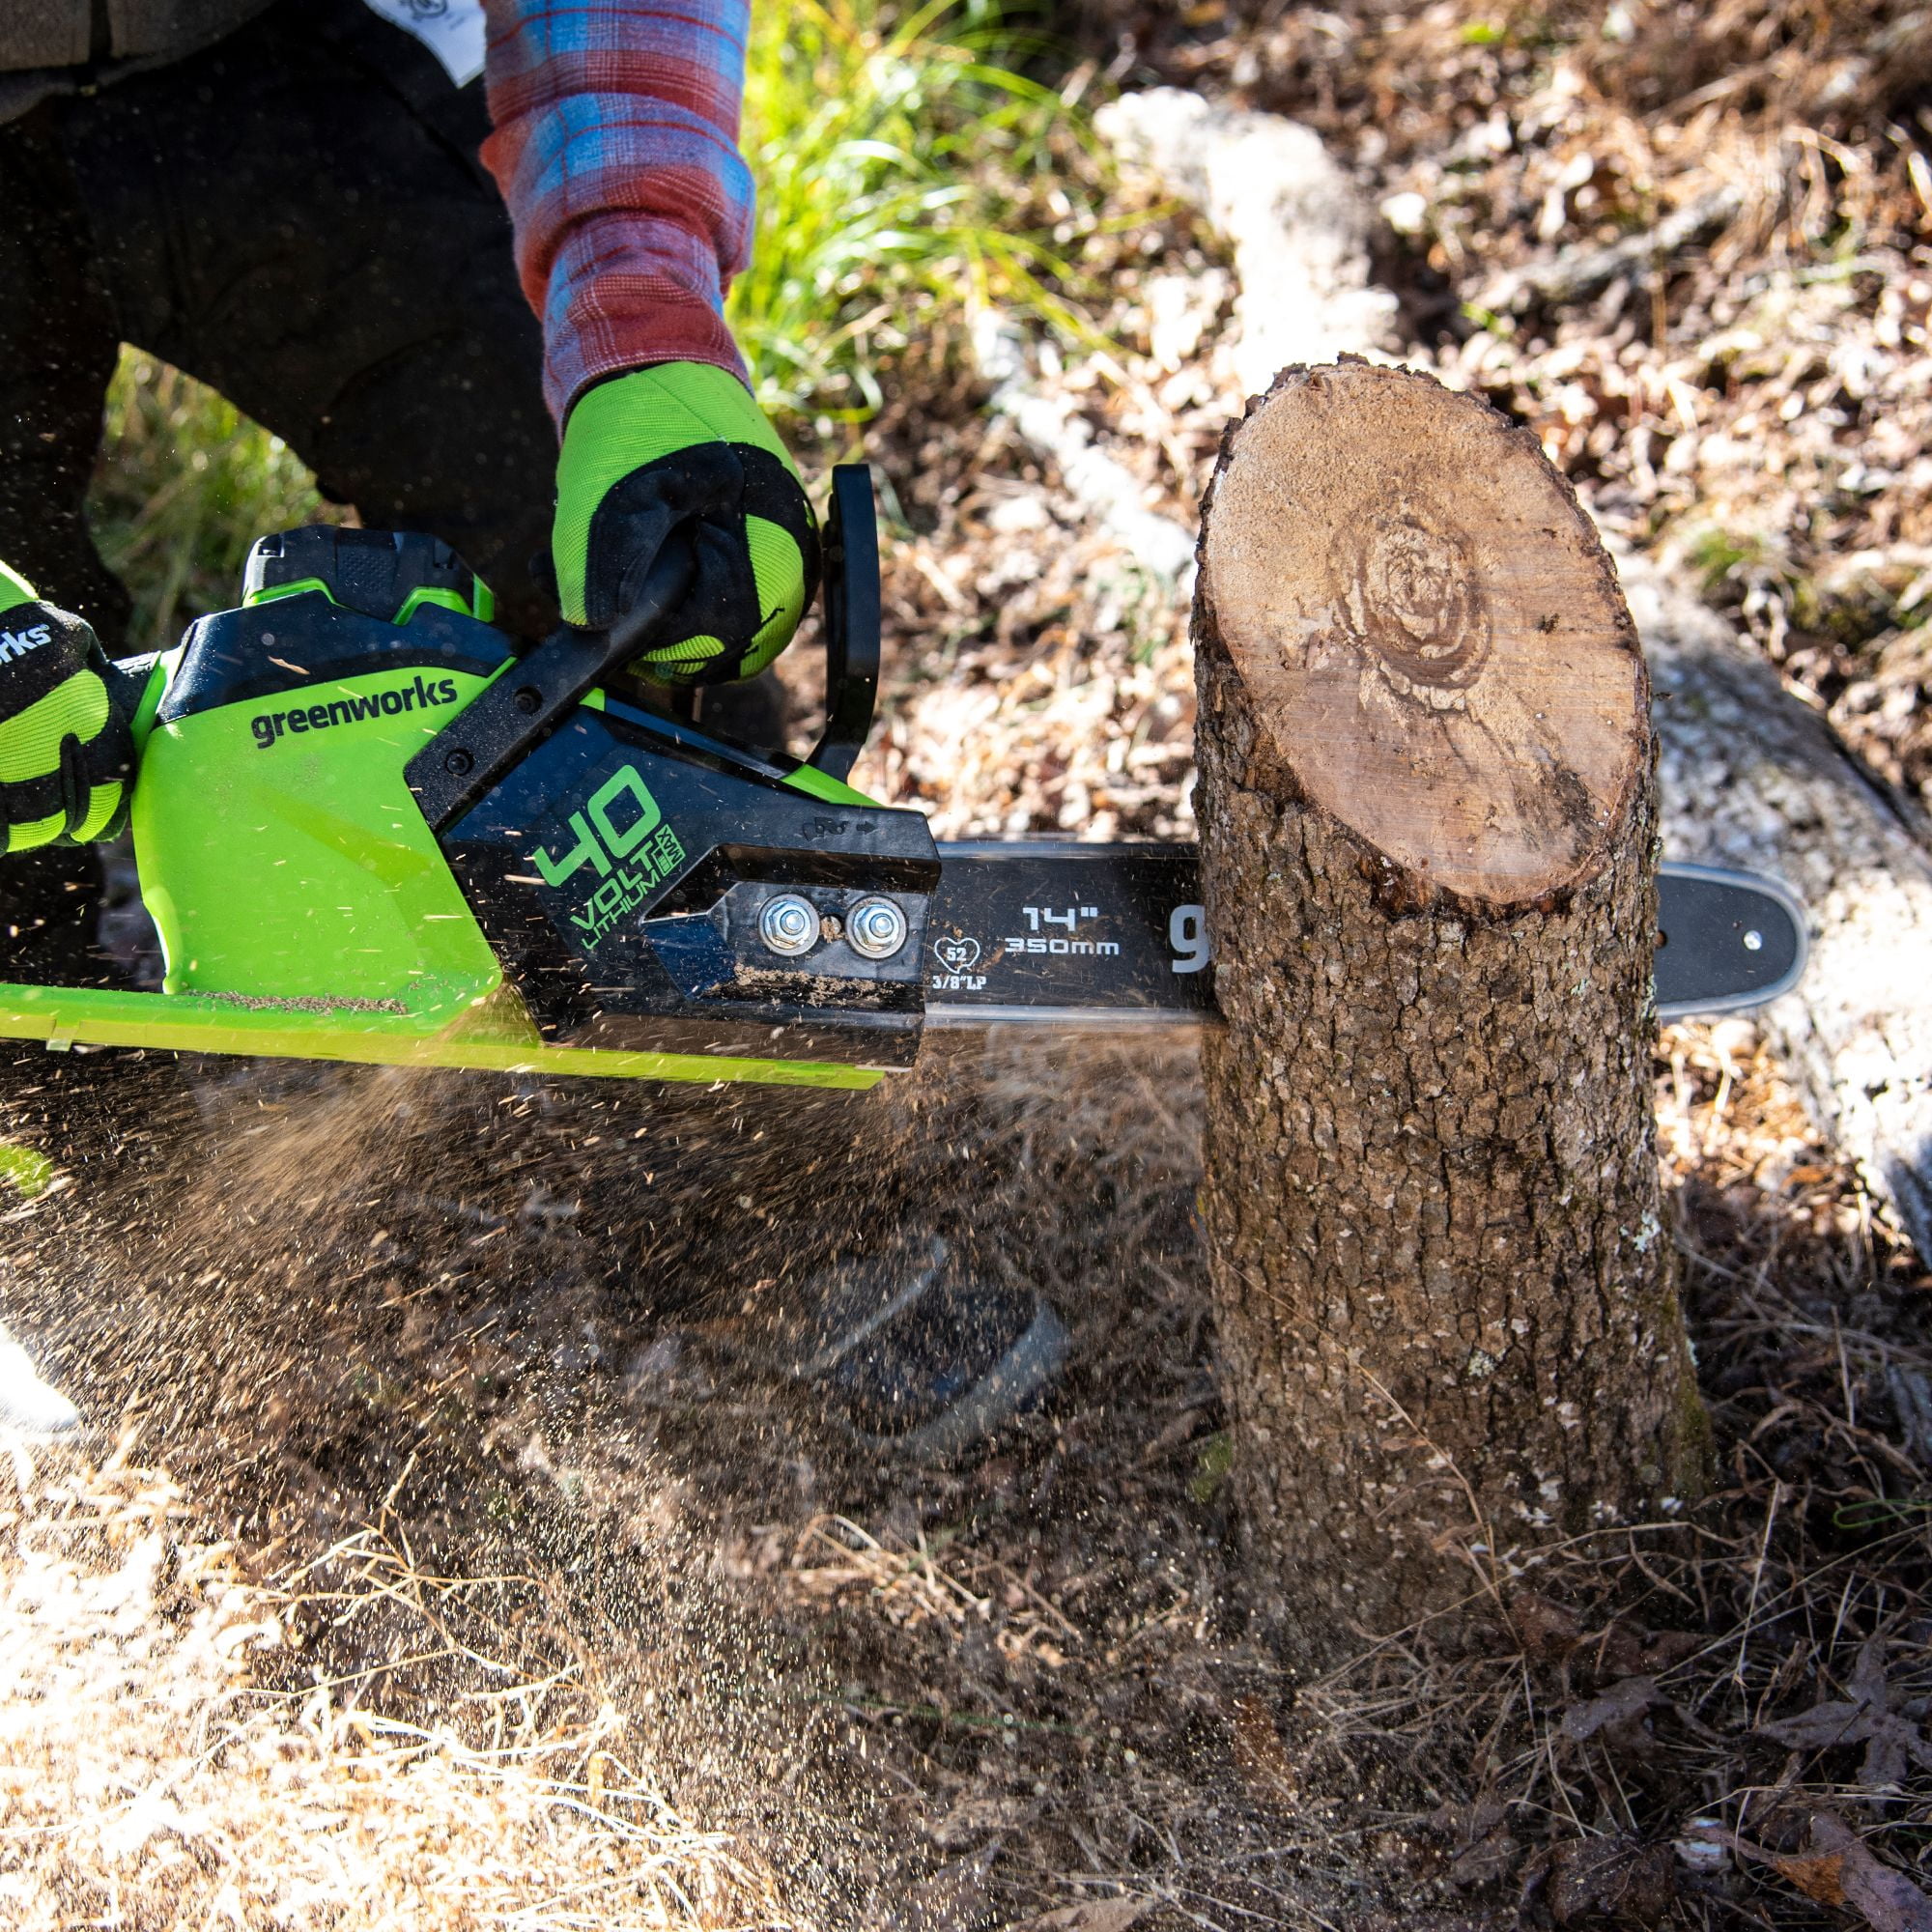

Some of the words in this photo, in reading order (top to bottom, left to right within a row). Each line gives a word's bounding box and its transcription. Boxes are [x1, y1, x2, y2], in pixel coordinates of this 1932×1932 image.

[0, 626, 51, 666] rks
[251, 675, 457, 750] greenworks
[532, 764, 662, 887] 40
[657, 827, 682, 865] MAX
[569, 839, 654, 930] VOLT
[582, 868, 661, 950] LITHIUM
[1022, 906, 1098, 932] 14"
[947, 947, 967, 962] 52
[1005, 937, 1120, 955] 350mm
